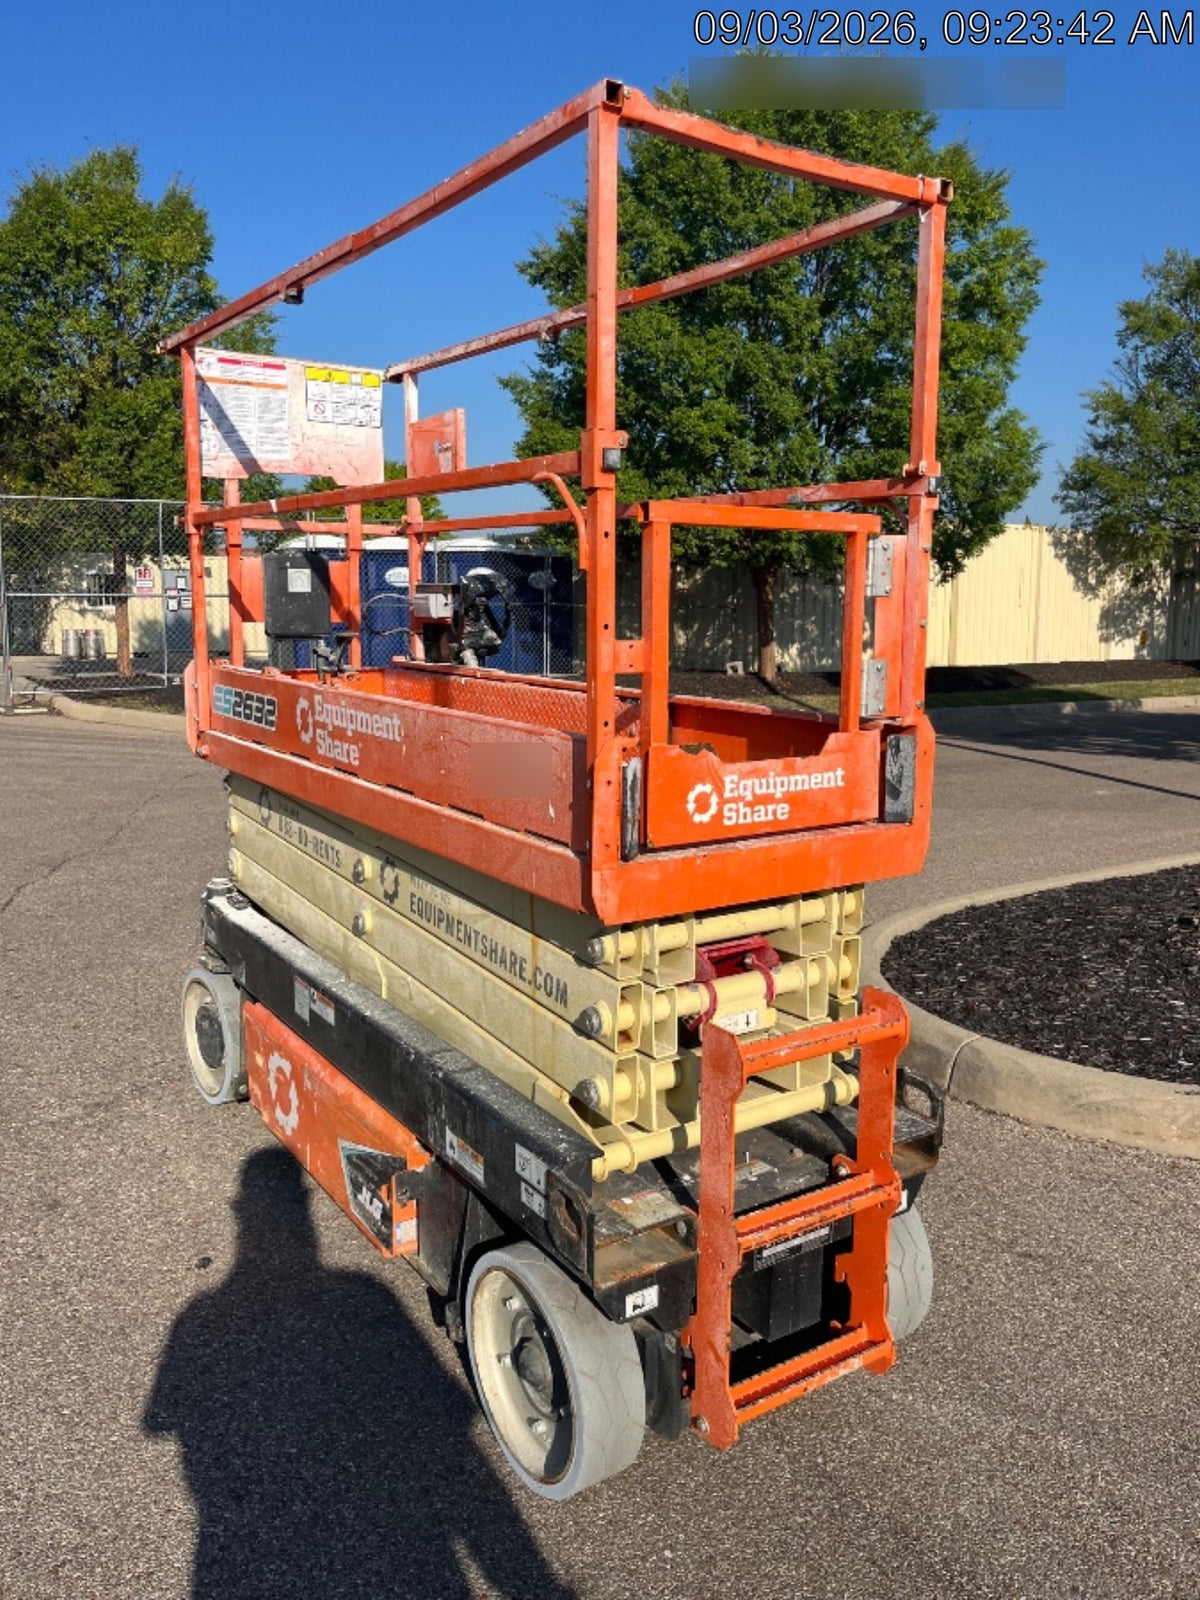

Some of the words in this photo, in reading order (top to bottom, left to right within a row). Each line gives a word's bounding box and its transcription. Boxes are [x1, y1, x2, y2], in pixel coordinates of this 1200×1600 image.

[213, 685, 277, 730] ES2632
[314, 694, 402, 742] Equipment
[316, 728, 360, 766] Share
[723, 767, 845, 800] Equipment
[723, 801, 790, 826] Share
[409, 891, 569, 1009] EQUIPMENTSHARE.COM
